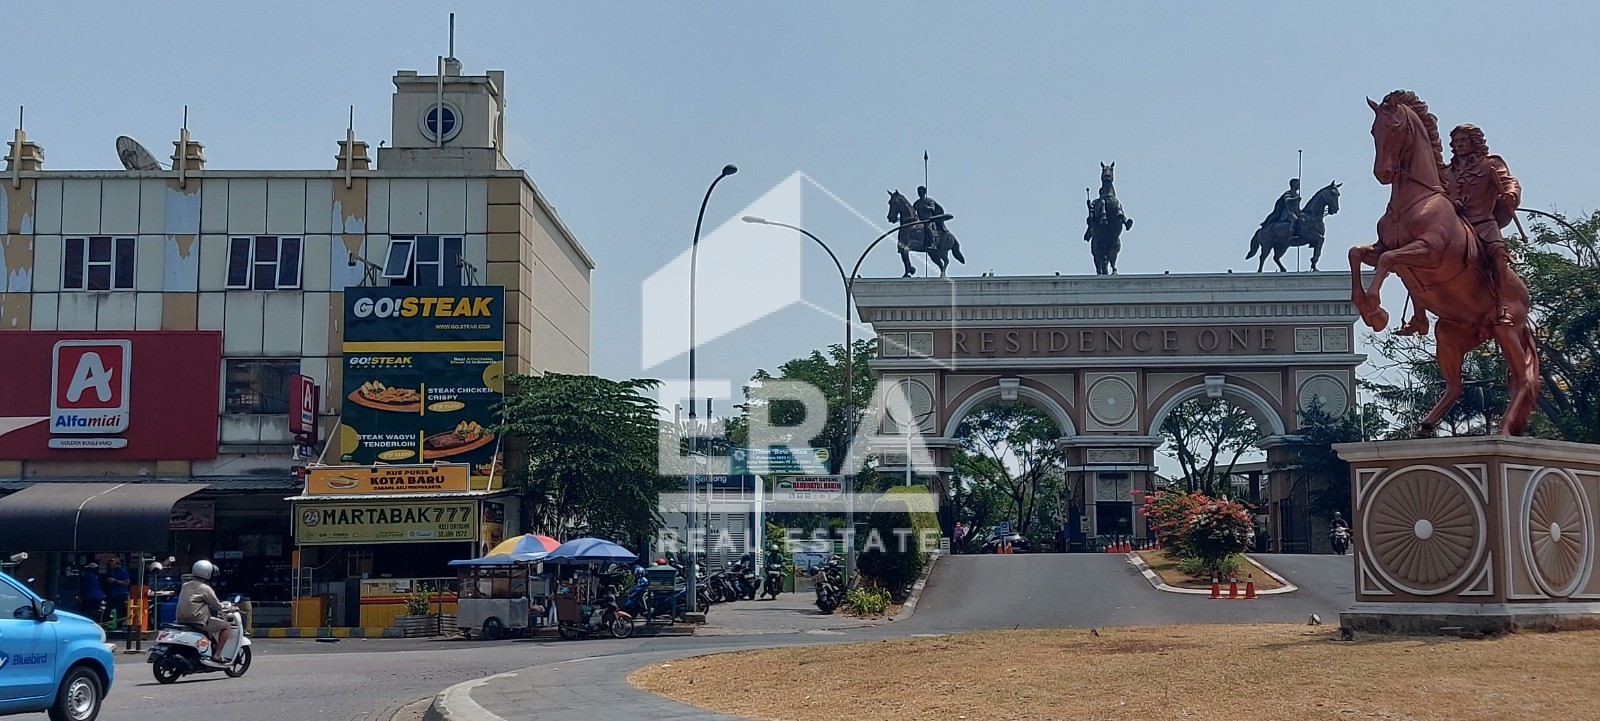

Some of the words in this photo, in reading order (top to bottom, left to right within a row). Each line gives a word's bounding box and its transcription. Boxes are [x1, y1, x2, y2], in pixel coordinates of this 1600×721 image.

[951, 329, 1180, 353] RESIDENCE
[1197, 328, 1278, 351] ONE
[55, 414, 121, 427] Alfamidi
[370, 476, 405, 485] KOTA
[407, 475, 445, 484] BARU
[322, 507, 431, 525] MARTABAK
[432, 506, 472, 522] 777
[12, 652, 48, 666] Bluebird
